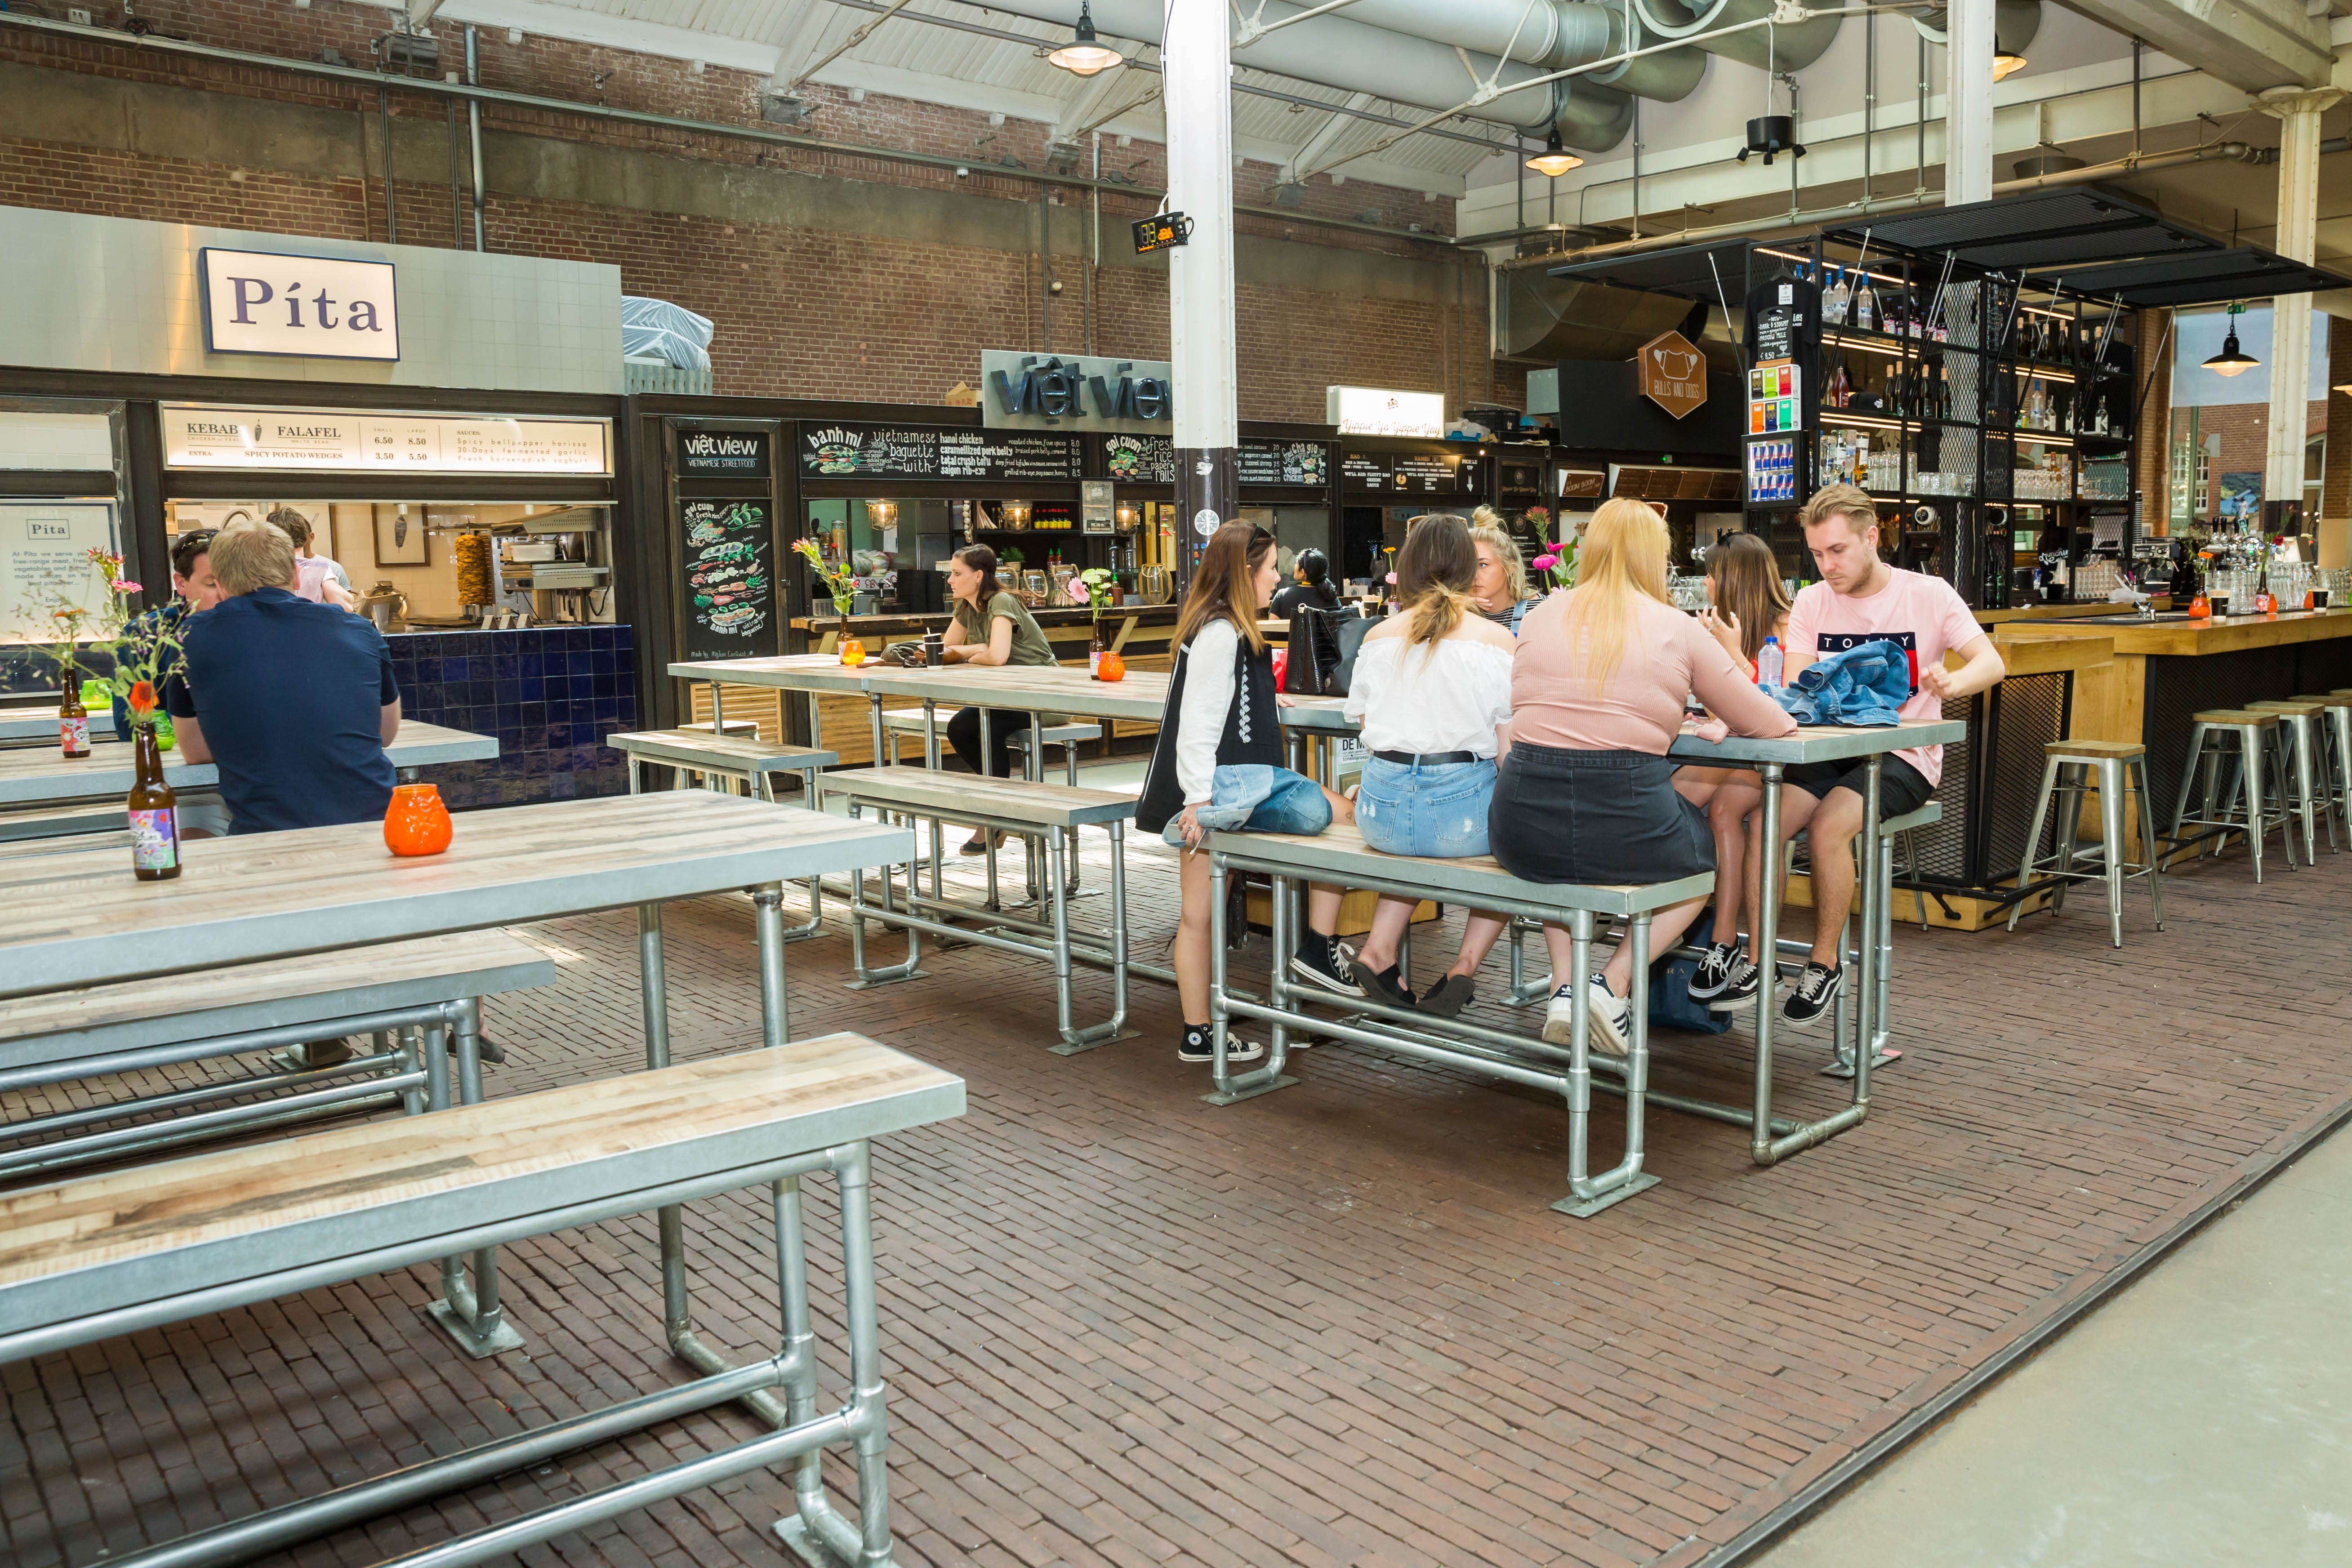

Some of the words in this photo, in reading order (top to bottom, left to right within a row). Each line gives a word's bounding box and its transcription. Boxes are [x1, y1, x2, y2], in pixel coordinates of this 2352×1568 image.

[227, 277, 383, 332] Píta
[1089, 362, 1172, 420] vie
[1654, 380, 1671, 396] BULLS
[1674, 382, 1684, 397] AND
[1686, 383, 1699, 399] DOGS
[187, 423, 238, 434] KEBAB
[277, 426, 341, 437] FALAFEL
[1343, 419, 1373, 434] Yippie
[1376, 421, 1389, 435] Yo
[1391, 422, 1420, 437] Yippie
[1422, 423, 1442, 438] Yay
[374, 437, 393, 445] 6.50
[408, 437, 426, 445] 8.50
[807, 427, 843, 449] banh
[845, 431, 863, 448] mi
[873, 429, 935, 443] vietnamese
[940, 432, 958, 444] hanoi
[958, 433, 984, 444] chicken
[491, 439, 543, 447] bellpepper
[717, 436, 757, 454] view
[1106, 435, 1120, 456] goi
[1120, 436, 1142, 453] cuon
[1146, 437, 1174, 454] fresh
[1307, 443, 1318, 454] gio
[409, 453, 427, 461] 5.50
[890, 443, 934, 462] baguette
[940, 446, 981, 455] caramellized
[981, 446, 996, 457] pork
[996, 446, 1013, 456] belly
[1154, 451, 1172, 463] rice
[903, 459, 931, 472] with
[941, 455, 957, 466] total
[958, 456, 975, 466] crush
[976, 457, 991, 466] tofu
[1004, 458, 1015, 467] fried
[1151, 463, 1170, 471] paper
[940, 466, 961, 477] saigon
[962, 466, 985, 476] rib-eye
[1004, 468, 1019, 477] grilled
[1155, 469, 1175, 482] rolls
[1283, 467, 1302, 475] veggie
[1283, 474, 1304, 482] chicken
[1566, 483, 1580, 493] BOOM
[1581, 478, 1595, 488] BOOM
[686, 502, 696, 517] goi
[697, 503, 714, 512] cuon
[696, 511, 712, 522] fresh
[31, 525, 66, 534] Píta
[743, 611, 767, 629] vietnamese
[729, 625, 738, 634] mi
[1343, 739, 1354, 751] DE
